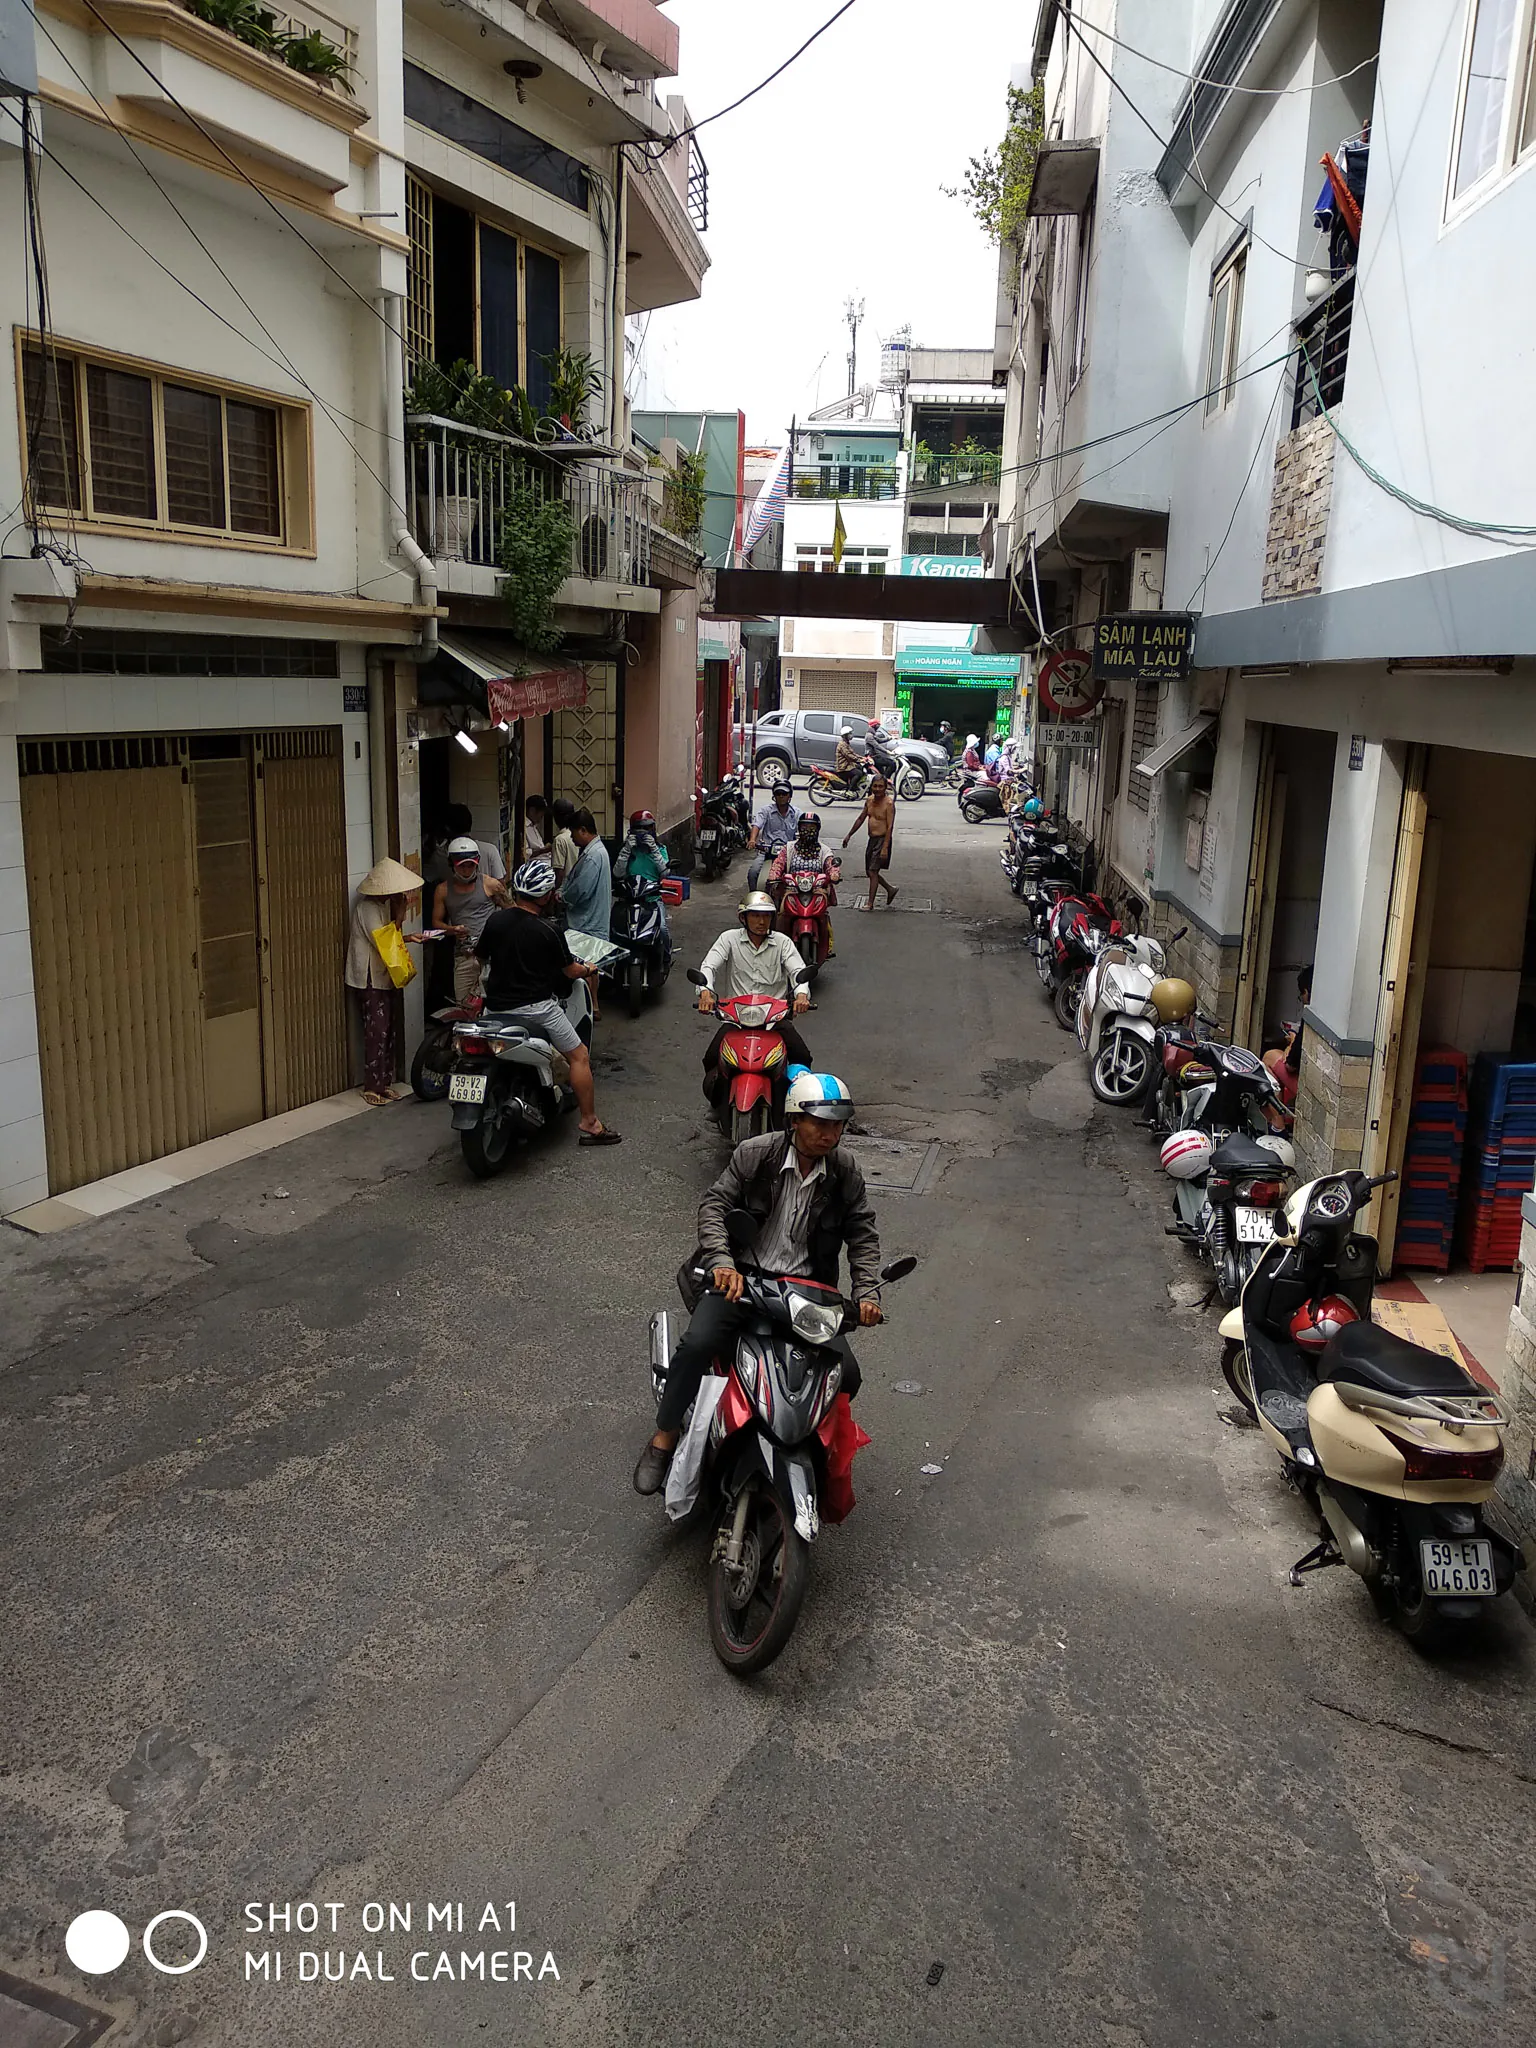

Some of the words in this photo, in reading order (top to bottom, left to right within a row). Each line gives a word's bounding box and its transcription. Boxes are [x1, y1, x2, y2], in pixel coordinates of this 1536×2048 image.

[1099, 620, 1135, 645] SÂM
[1142, 625, 1187, 649] LẠNH
[1103, 646, 1136, 666] MÍA
[1143, 650, 1181, 667] LAU
[455, 1076, 481, 1089] 59-V2
[450, 1088, 482, 1101] 469.83
[1244, 1210, 1272, 1225] 70-F
[1240, 1225, 1275, 1240] 514.2
[1430, 1544, 1480, 1566] 59-E1
[1428, 1568, 1491, 1591] 046.03
